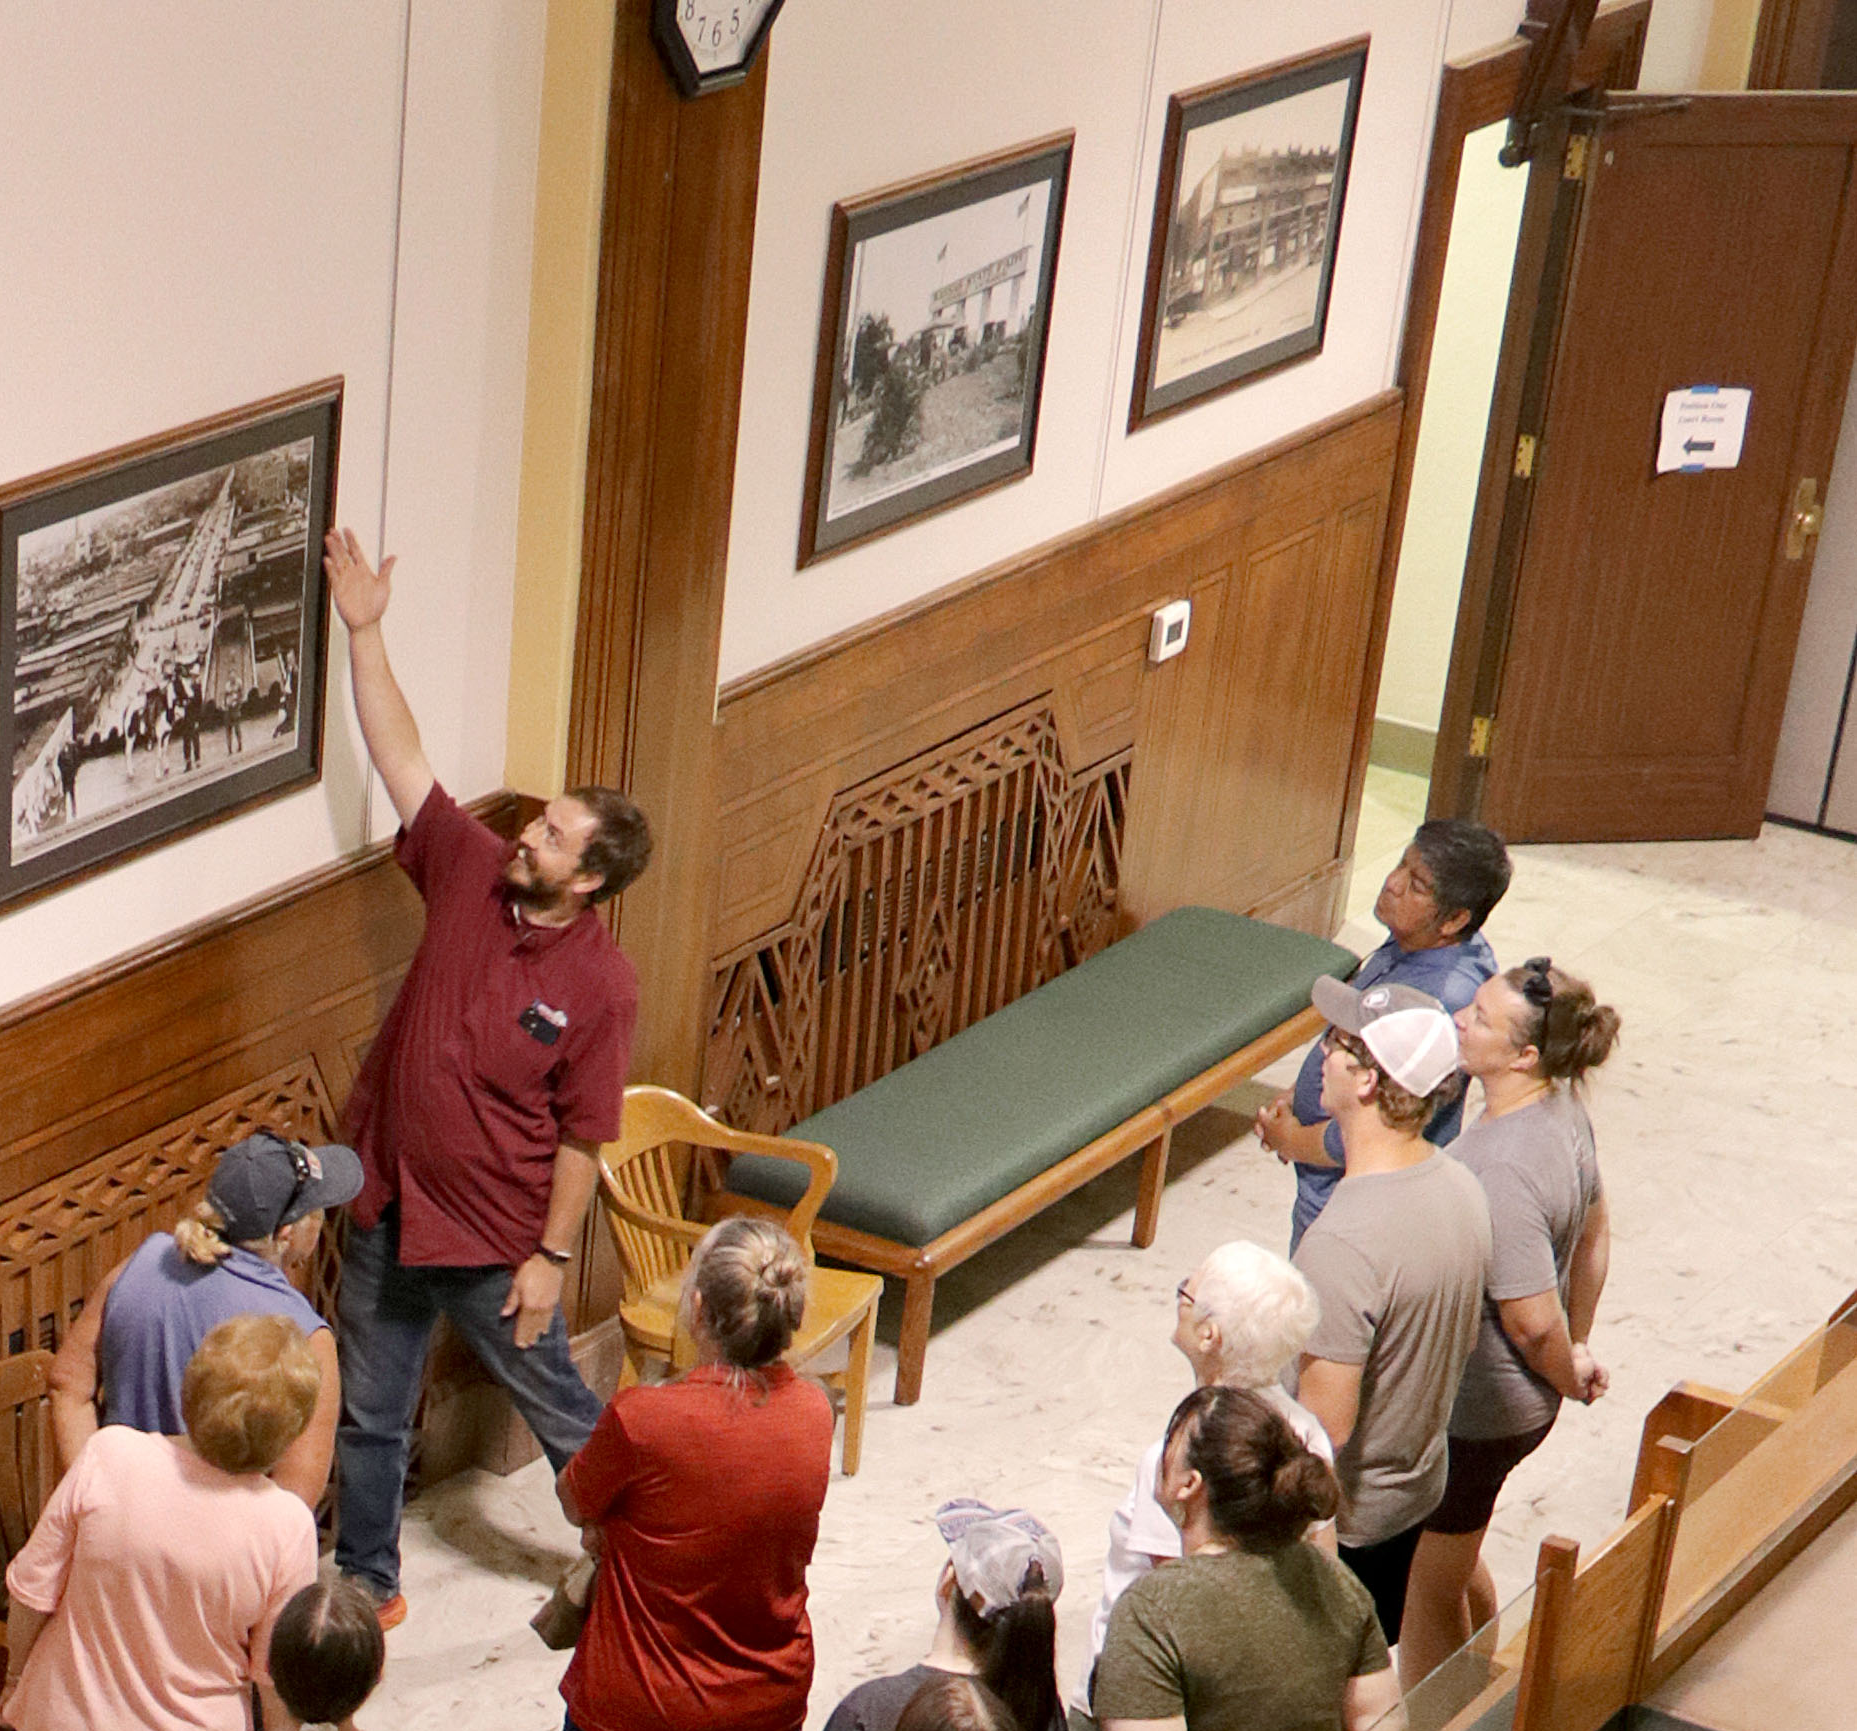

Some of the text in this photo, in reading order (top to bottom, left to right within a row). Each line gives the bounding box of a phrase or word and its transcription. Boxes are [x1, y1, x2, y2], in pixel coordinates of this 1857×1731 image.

[698, 16, 707, 43] 7
[712, 20, 722, 47] 6
[730, 7, 740, 35] 5
